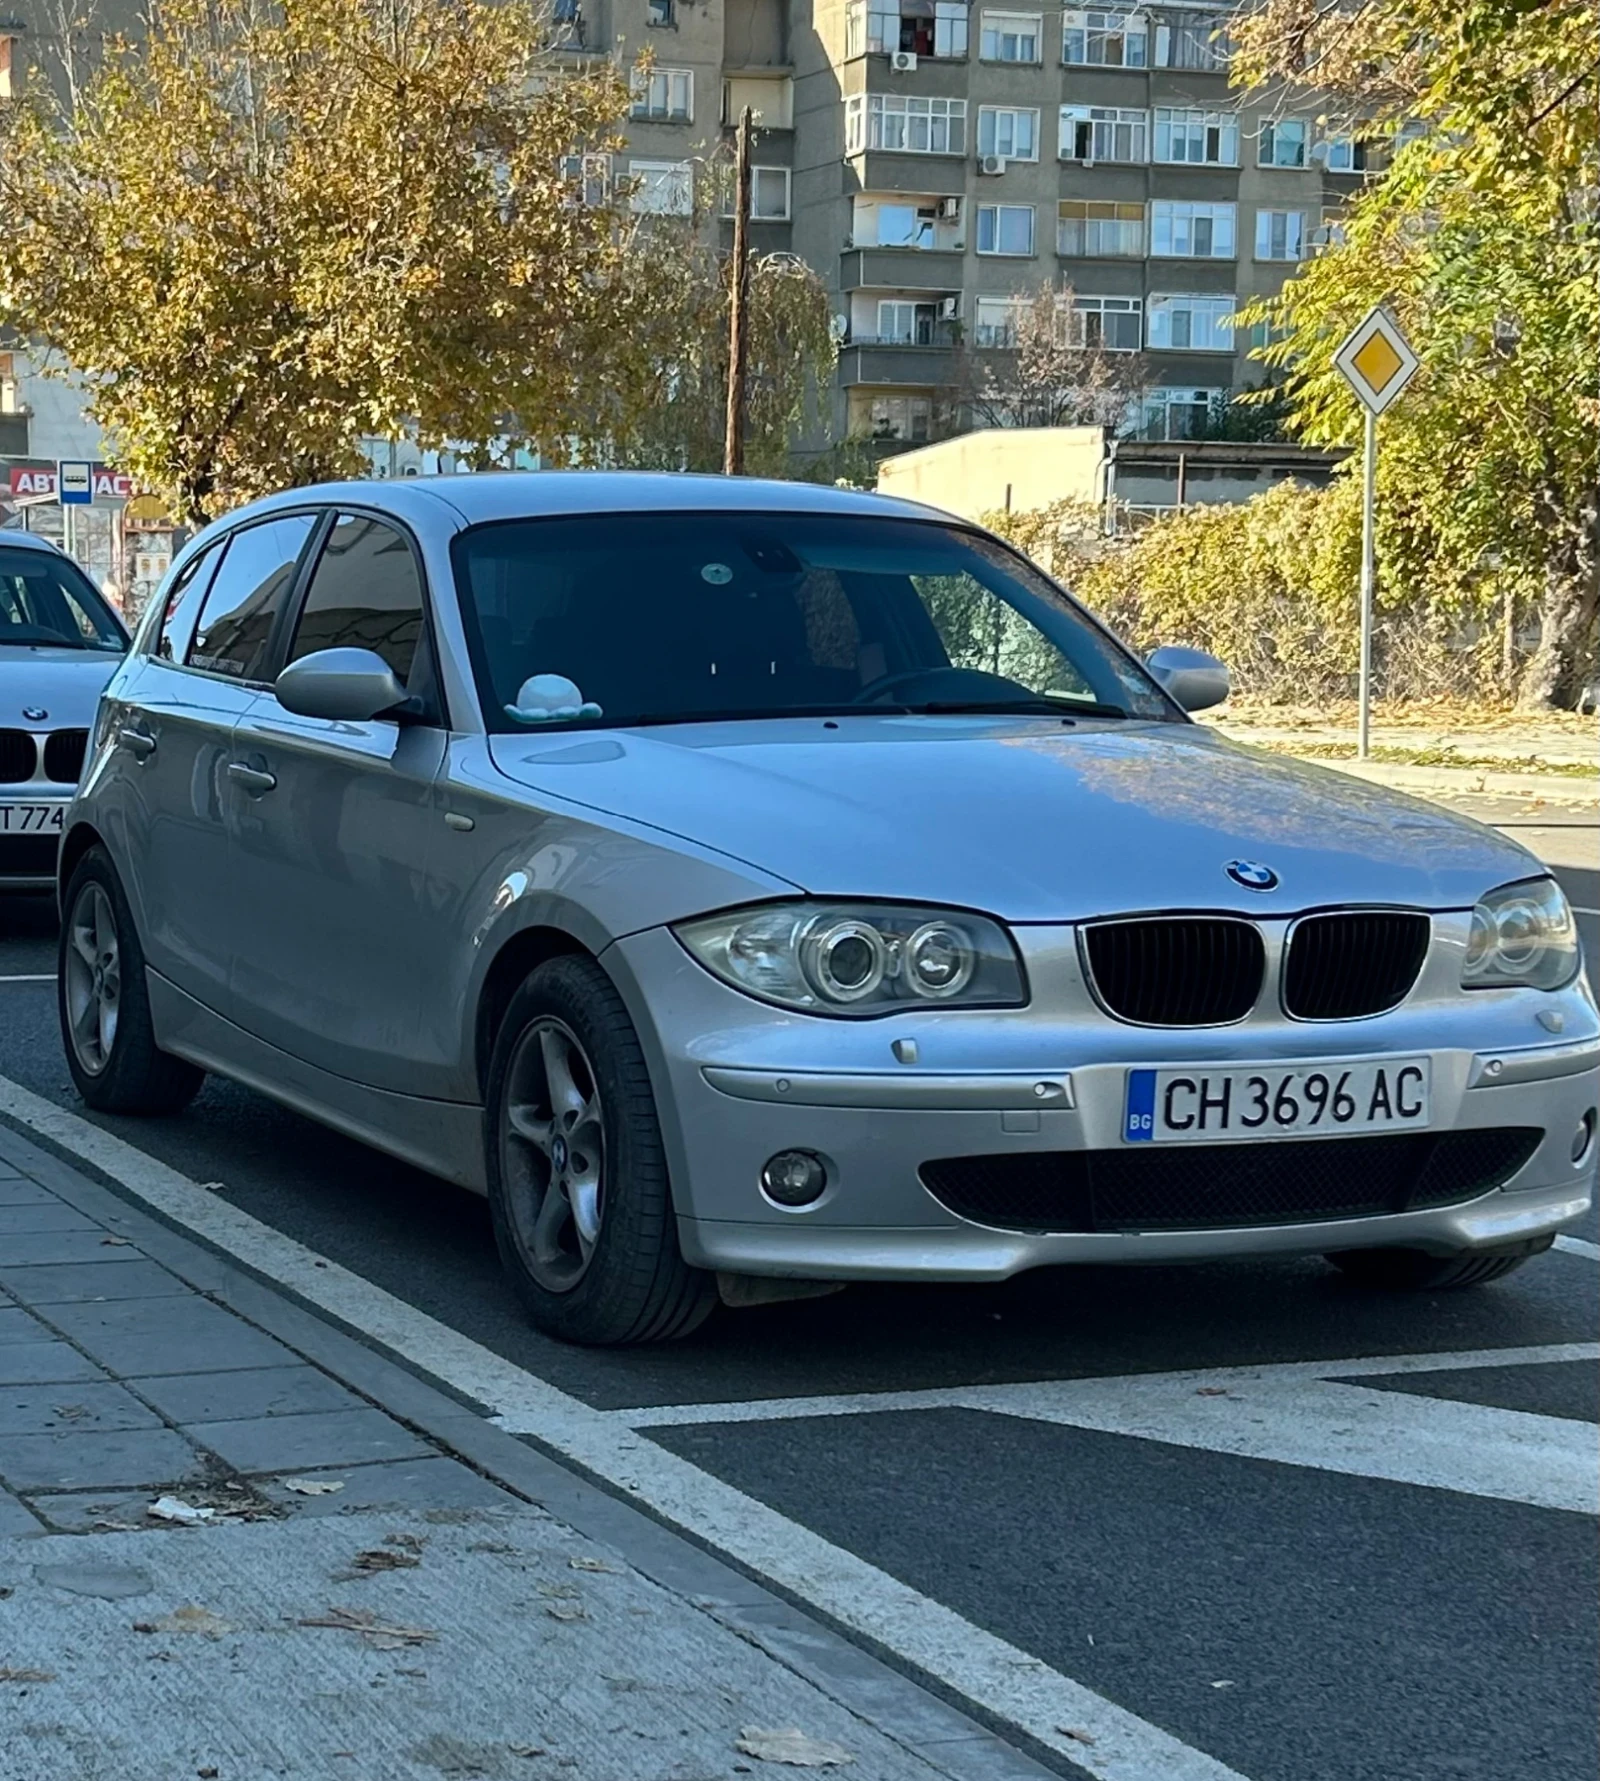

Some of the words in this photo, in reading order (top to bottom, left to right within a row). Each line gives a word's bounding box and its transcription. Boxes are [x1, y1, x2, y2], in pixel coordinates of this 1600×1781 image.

[1163, 1077, 1232, 1130] CH
[1241, 1071, 1356, 1128] 3696
[1366, 1065, 1423, 1121] AC
[1129, 1113, 1152, 1130] BG
